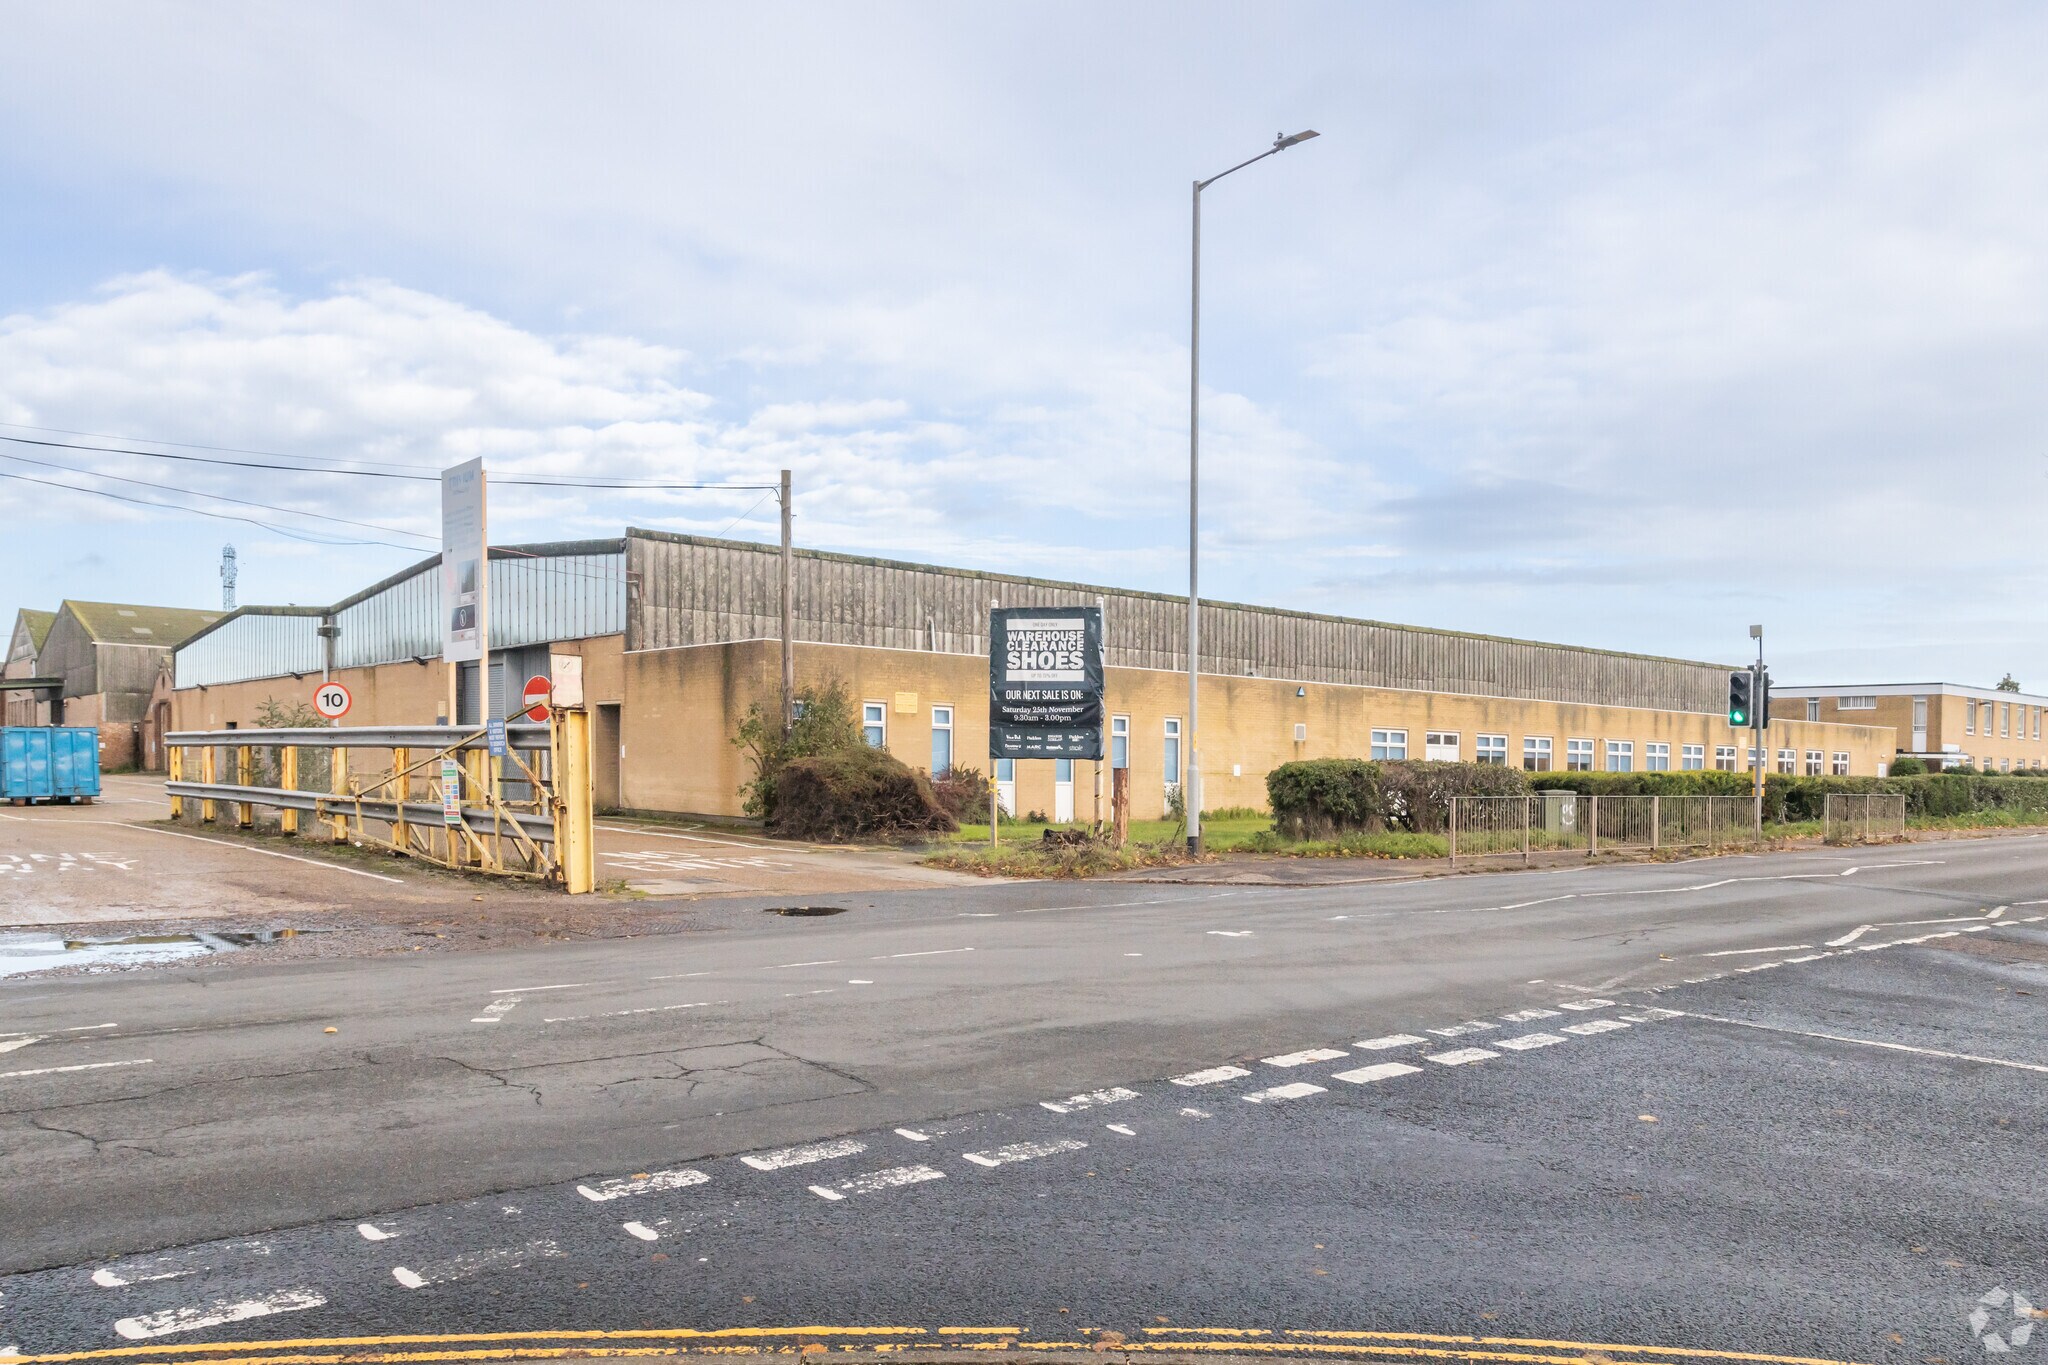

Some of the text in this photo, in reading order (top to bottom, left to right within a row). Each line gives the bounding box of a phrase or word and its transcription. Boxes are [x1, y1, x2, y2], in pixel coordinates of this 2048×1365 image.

[1007, 631, 1084, 641] WAREHOUSE
[1007, 641, 1084, 651] CLEARANCE
[1007, 651, 1084, 670] SHOES
[322, 693, 343, 707] 10
[1006, 690, 1084, 700] OUR NEXT SALE IS ON:
[1002, 706, 1031, 714] Saturday
